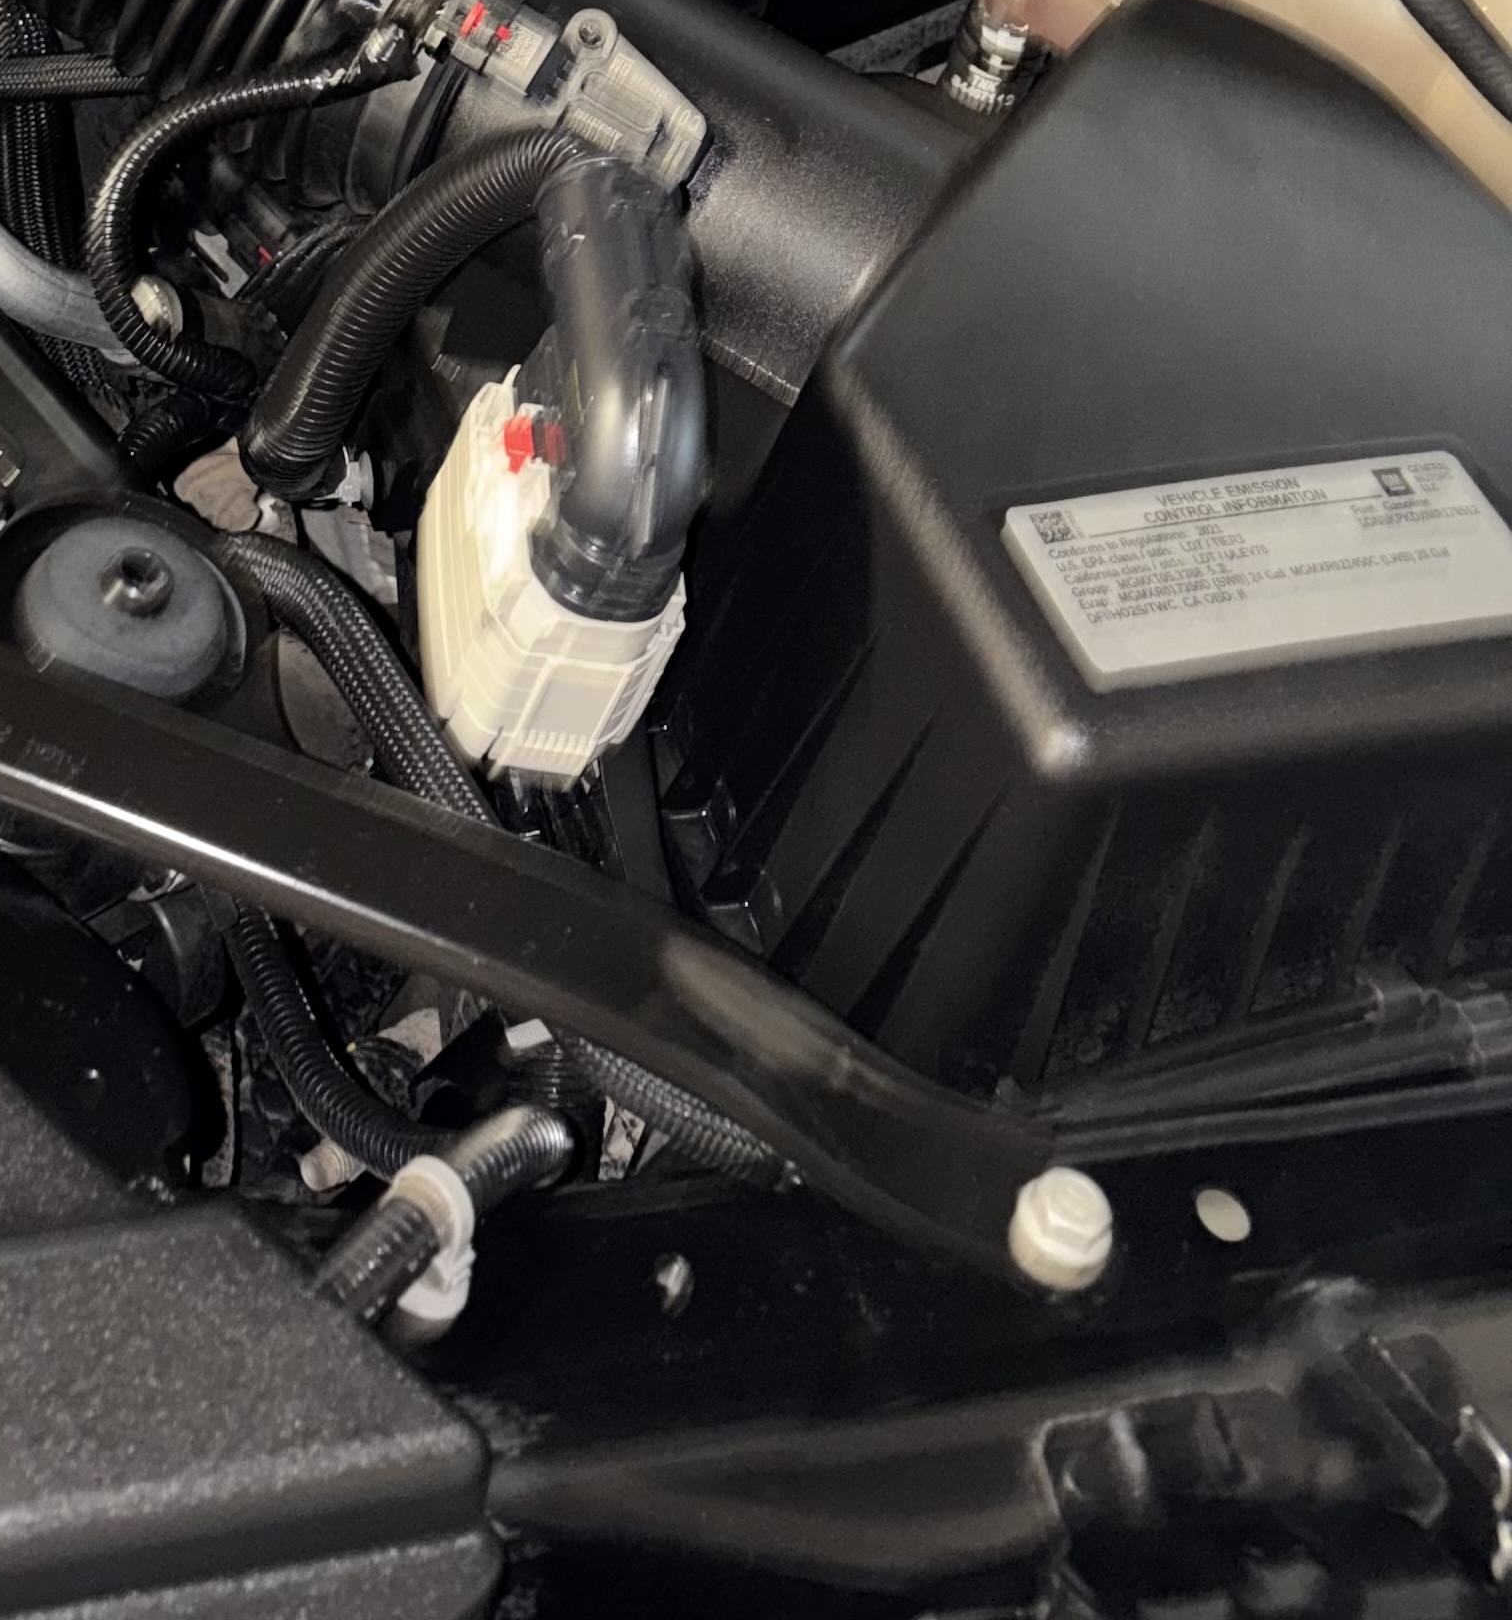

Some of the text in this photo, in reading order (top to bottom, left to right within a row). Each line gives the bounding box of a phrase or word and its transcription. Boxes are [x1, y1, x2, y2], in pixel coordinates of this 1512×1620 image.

[1143, 488, 1327, 523] CONTROL INFORMATION
[1157, 478, 1299, 506] VEHICLE EMISSION
[1050, 543, 1104, 558] Conforms
[1197, 524, 1220, 534] 2021
[1058, 561, 1079, 571] U.S.
[1084, 557, 1105, 566] EPA
[1110, 552, 1137, 562] class
[1181, 541, 1202, 550] LDT
[1212, 534, 1244, 545] TIER3
[1064, 568, 1120, 583] California
[1121, 564, 1149, 574] class
[1194, 553, 1216, 562] LDT
[1072, 583, 1111, 596] Group:
[1183, 596, 1201, 606] CA
